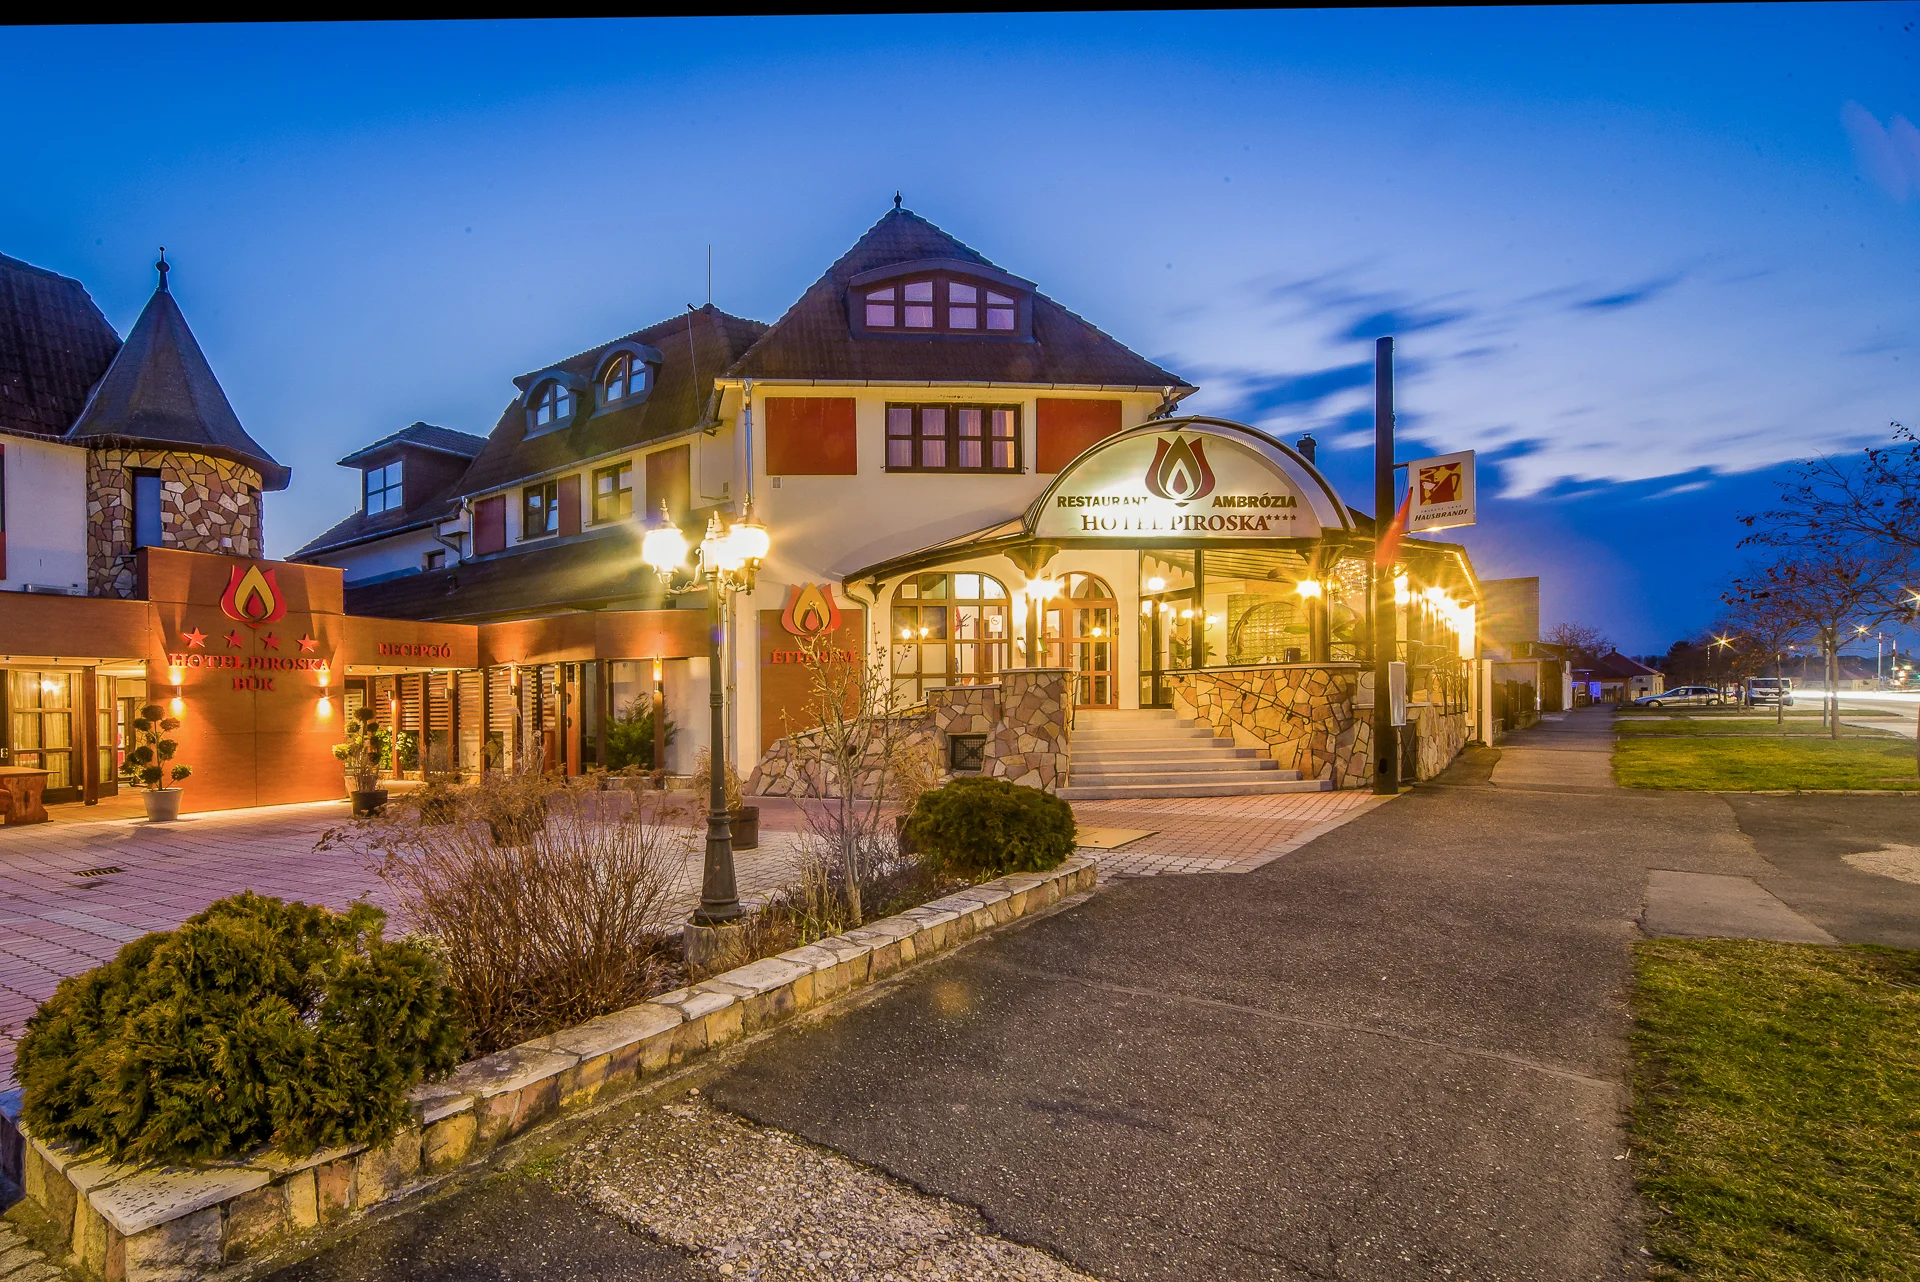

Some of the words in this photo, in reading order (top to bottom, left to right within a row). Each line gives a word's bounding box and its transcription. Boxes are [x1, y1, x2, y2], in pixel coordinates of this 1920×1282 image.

[1057, 496, 1149, 508] RESTAURANT
[1212, 492, 1297, 508] AMBRÓZIA
[1414, 508, 1469, 522] HAUSBRANDT
[377, 642, 453, 659] RECEPCIÓ
[168, 653, 245, 669] HOTEL
[249, 655, 331, 672] PIROSKA
[232, 675, 276, 691] BÜK
